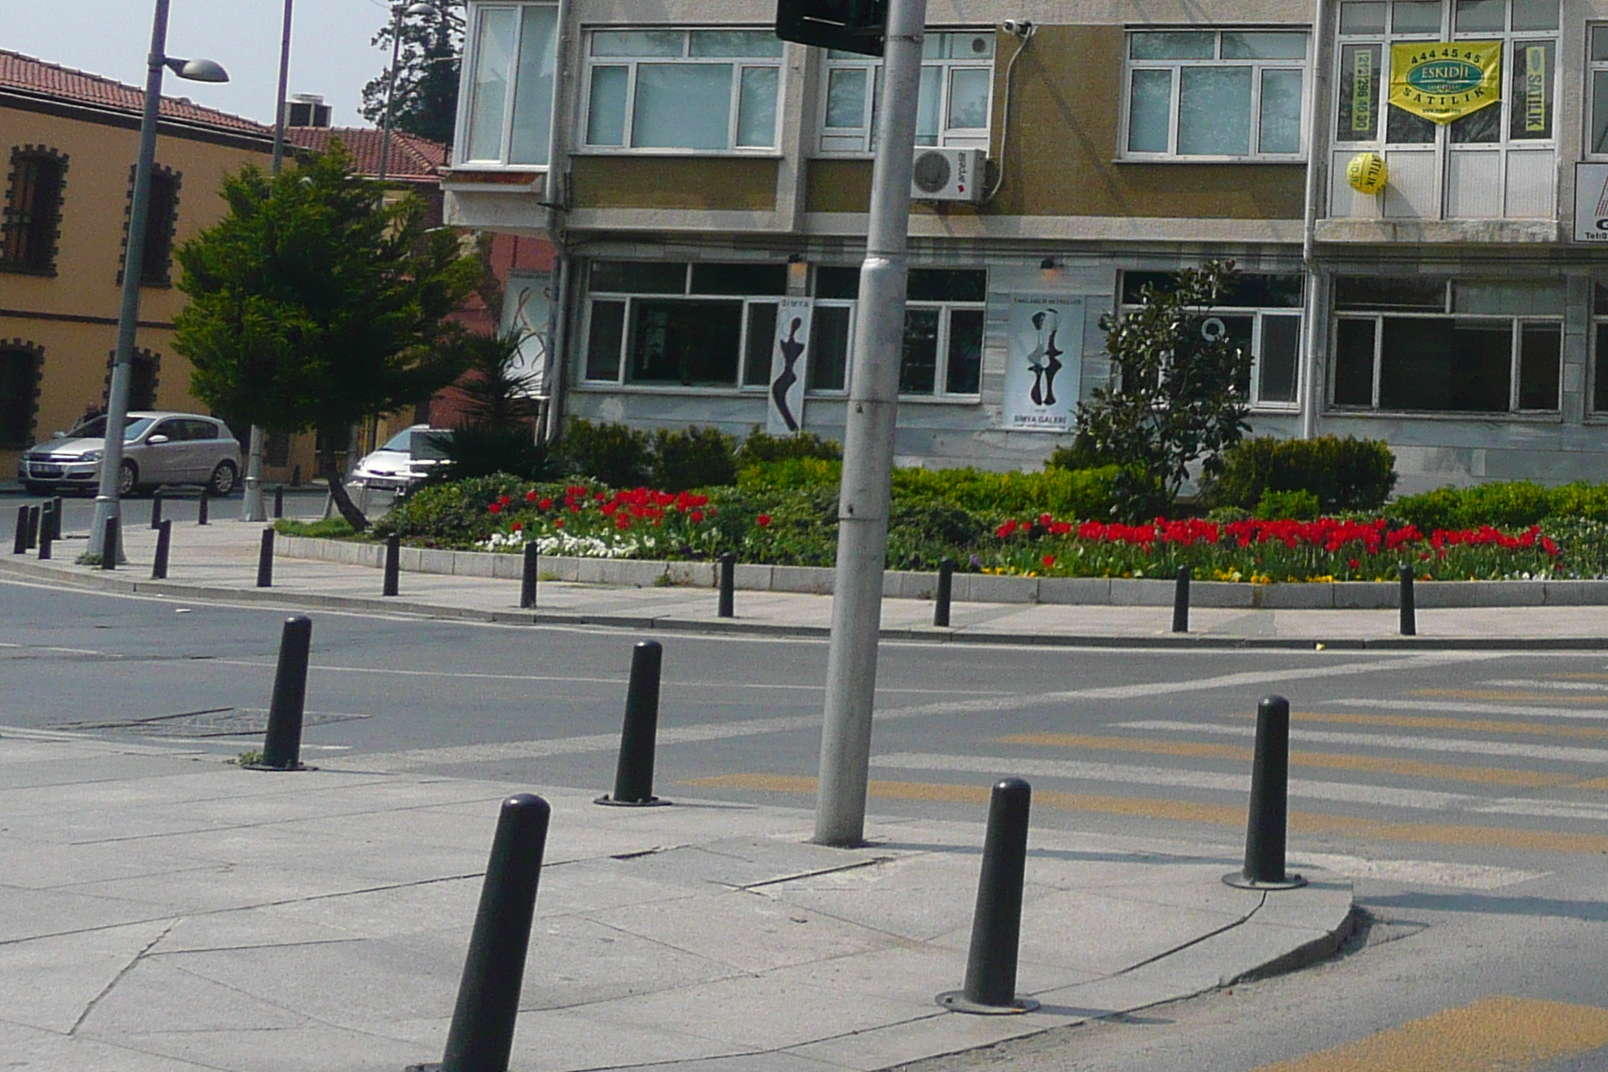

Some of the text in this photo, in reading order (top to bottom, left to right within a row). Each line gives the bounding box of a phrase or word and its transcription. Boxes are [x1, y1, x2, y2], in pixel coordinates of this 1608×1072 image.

[1411, 48, 1482, 64] 444 45 45
[1403, 87, 1485, 105] SATILIK
[1528, 74, 1542, 126] SATILIK
